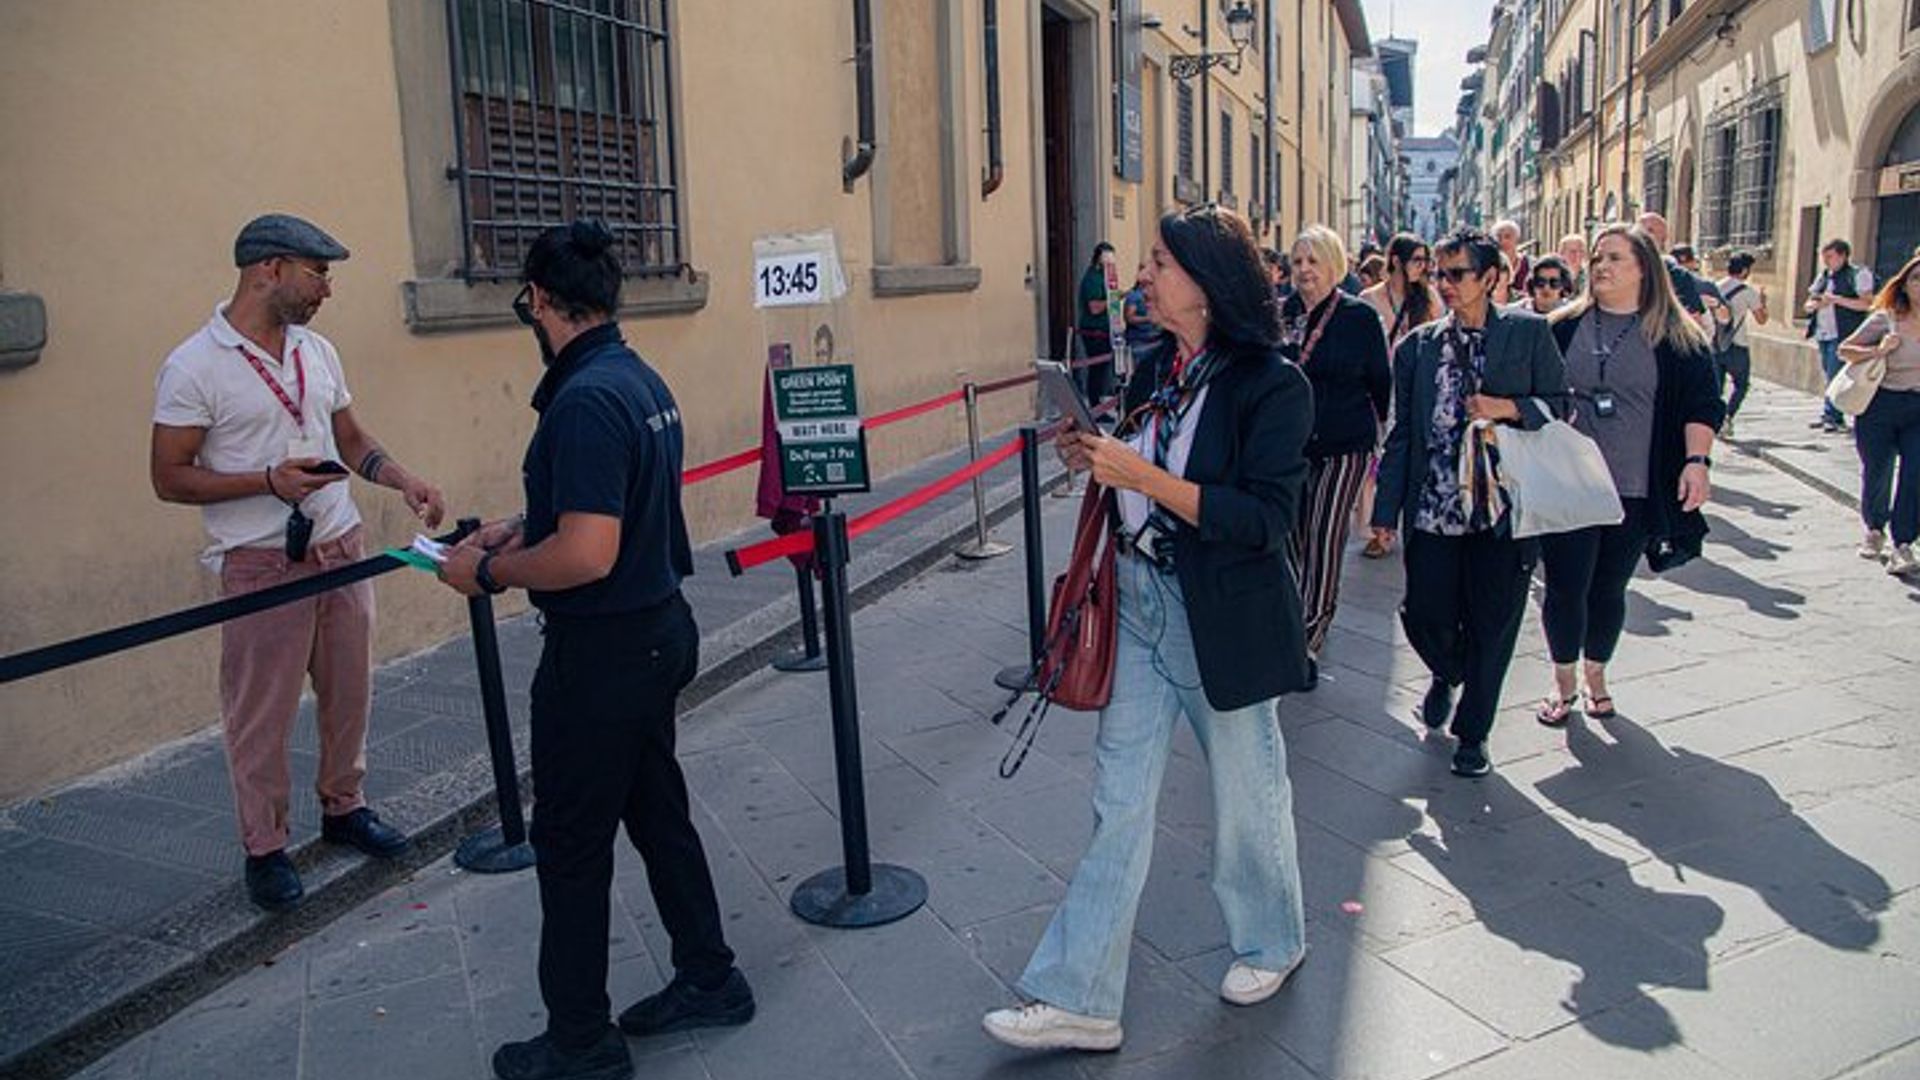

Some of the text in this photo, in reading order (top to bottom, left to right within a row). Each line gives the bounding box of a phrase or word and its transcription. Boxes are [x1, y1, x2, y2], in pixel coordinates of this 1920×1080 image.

[759, 261, 818, 298] 13:45
[781, 372, 848, 389] GREEN POINT
[791, 422, 847, 436] WAIT HERE
